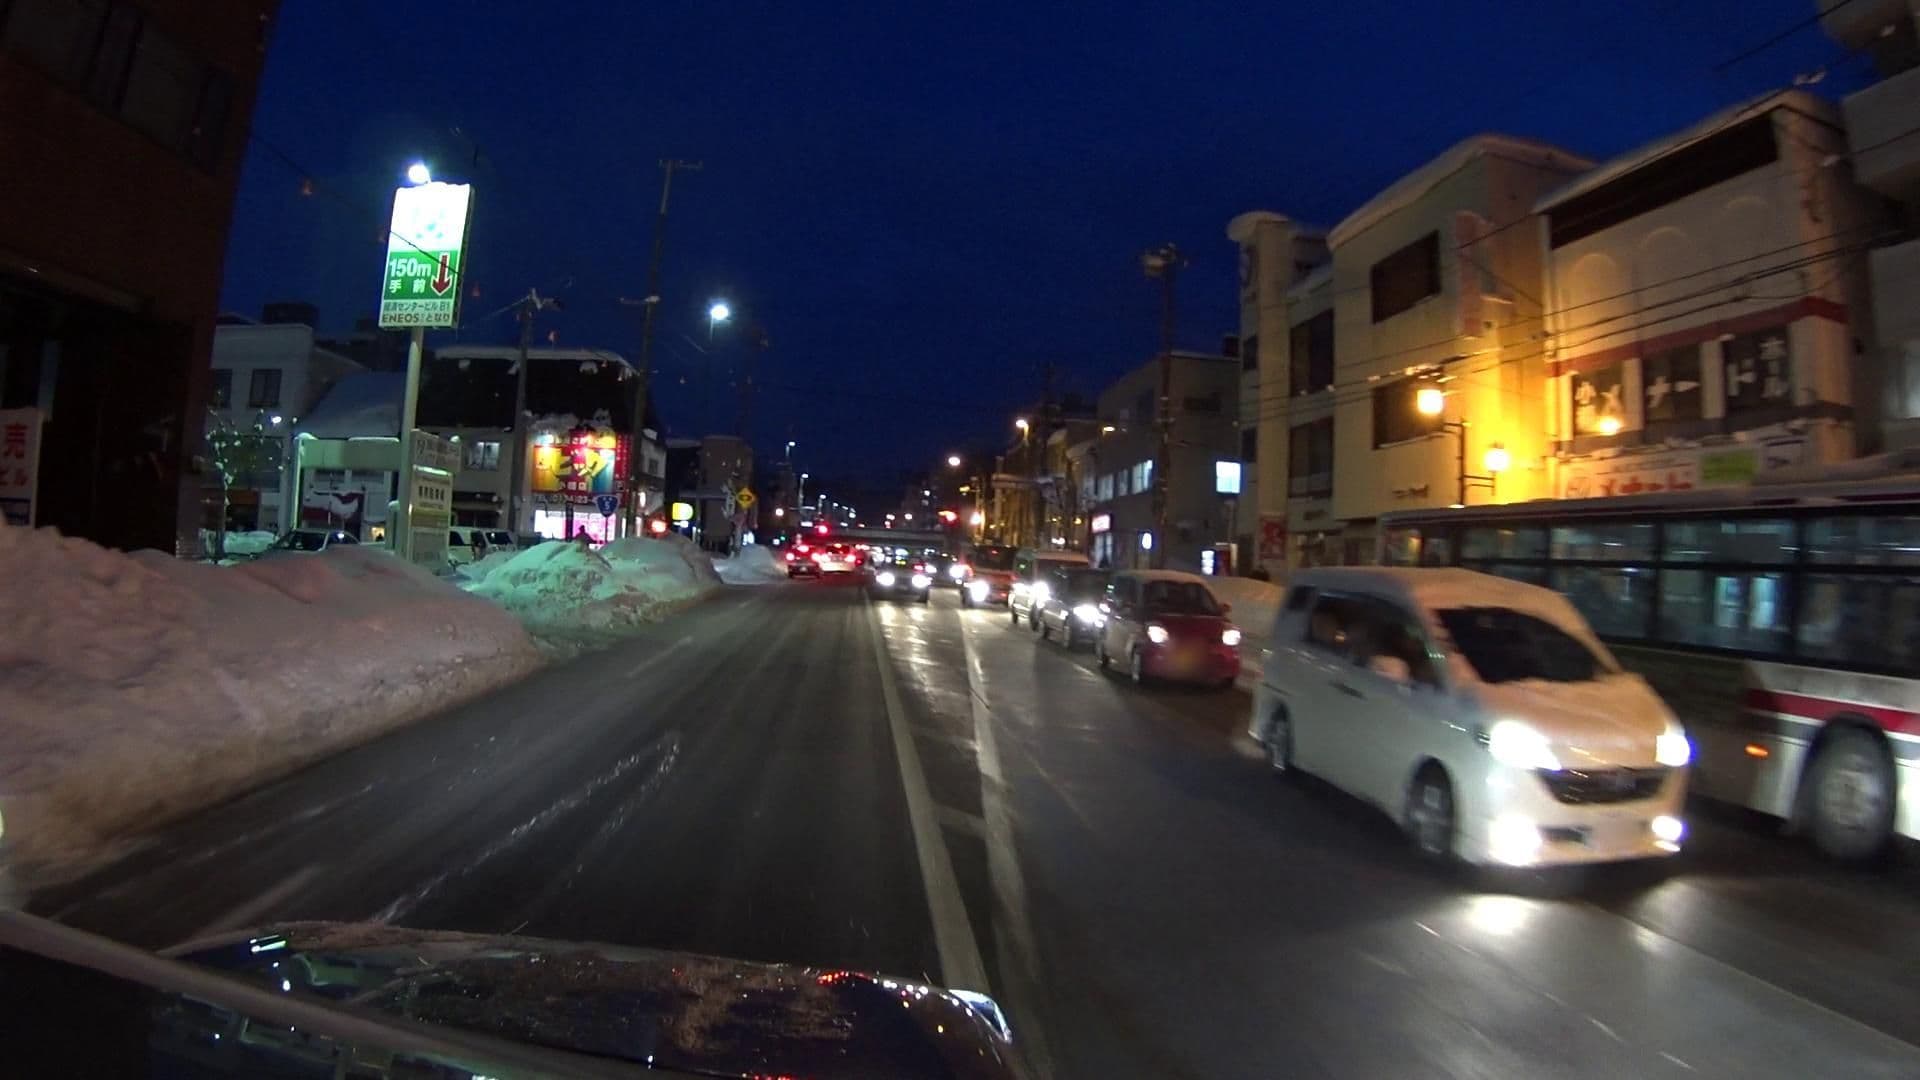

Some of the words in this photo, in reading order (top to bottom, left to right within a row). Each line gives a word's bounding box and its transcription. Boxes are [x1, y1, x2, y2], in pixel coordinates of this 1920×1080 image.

[389, 257, 432, 277] 150m
[382, 313, 419, 323] ENEOS
[604, 501, 611, 511] 5
